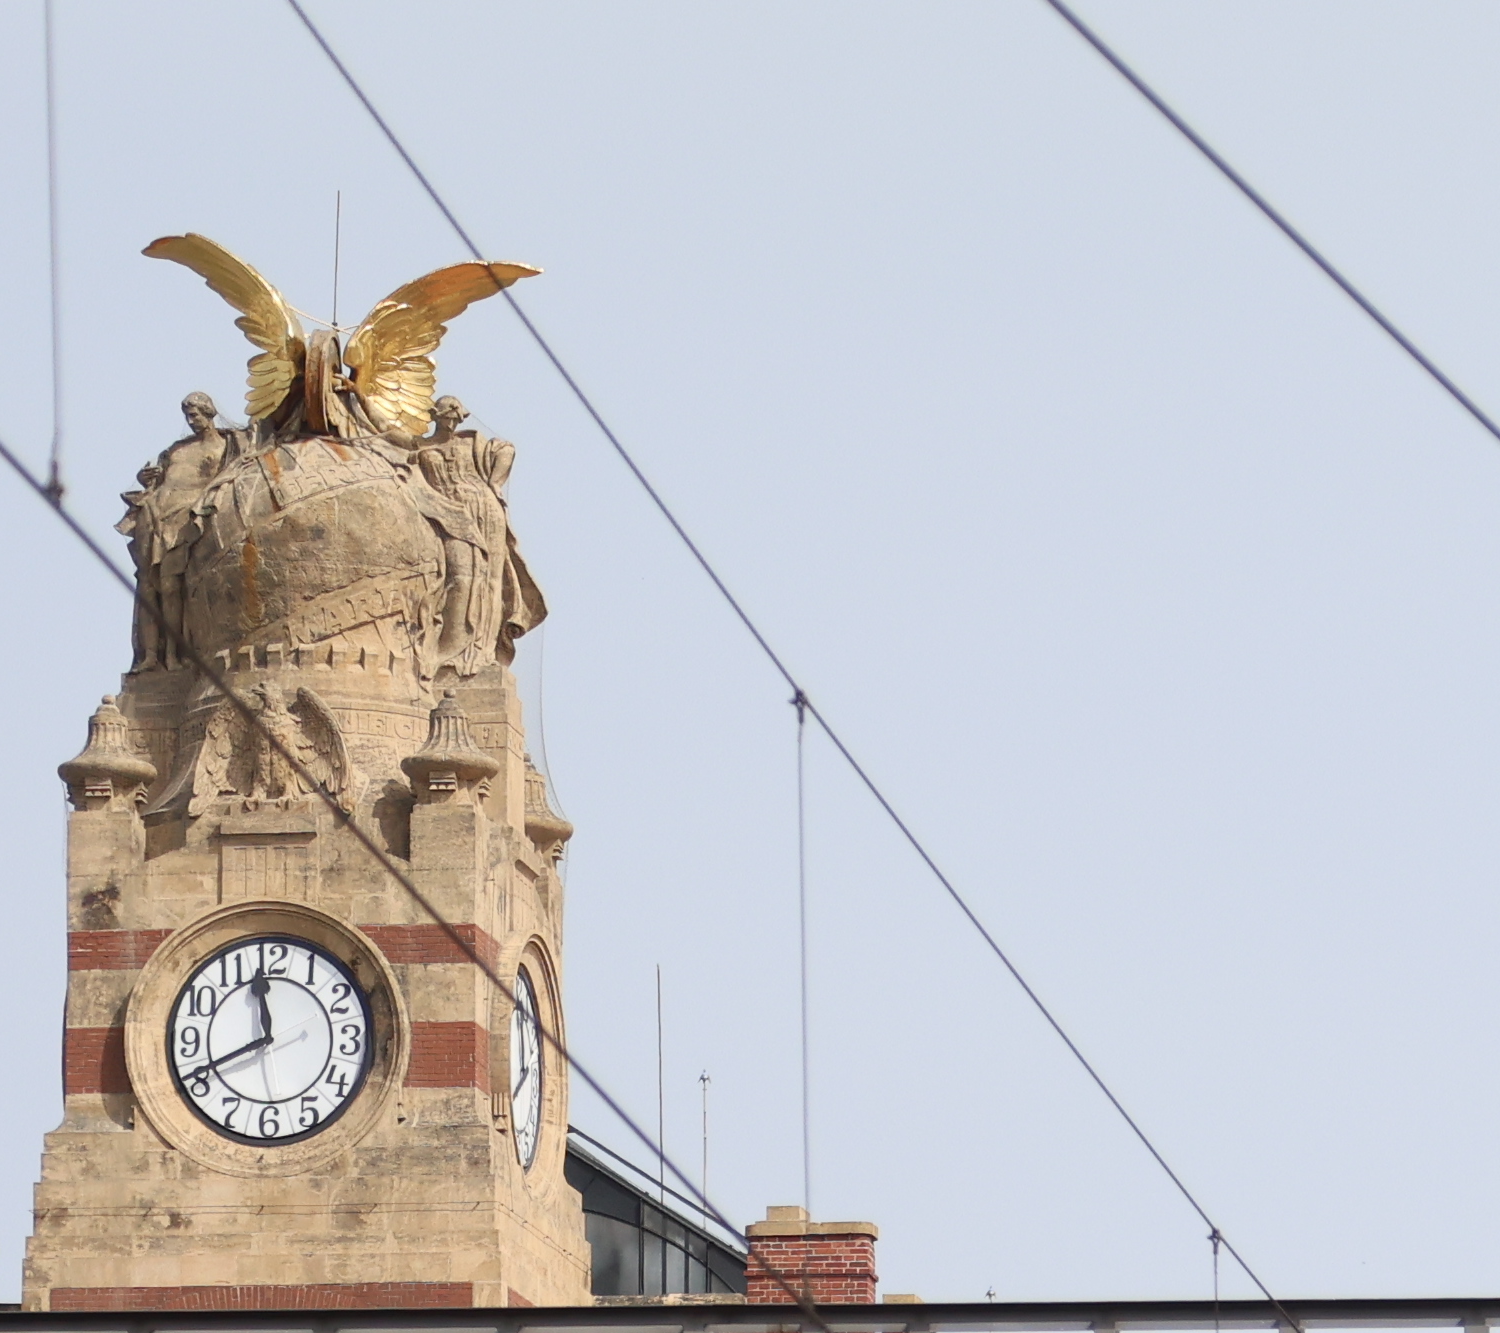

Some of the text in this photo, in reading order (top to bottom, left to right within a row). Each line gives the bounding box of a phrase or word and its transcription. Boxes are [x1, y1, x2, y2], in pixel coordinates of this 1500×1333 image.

[219, 953, 245, 987] 11
[256, 944, 289, 976] 12
[305, 953, 316, 986] 1
[188, 985, 217, 1017] 10
[331, 983, 351, 1014] 2
[180, 1026, 200, 1057] 9
[339, 1024, 361, 1055] 3
[190, 1065, 210, 1097] 8
[324, 1064, 349, 1098] 4
[222, 1097, 241, 1129] 7
[259, 1106, 280, 1137] 6
[300, 1096, 320, 1127] 5
